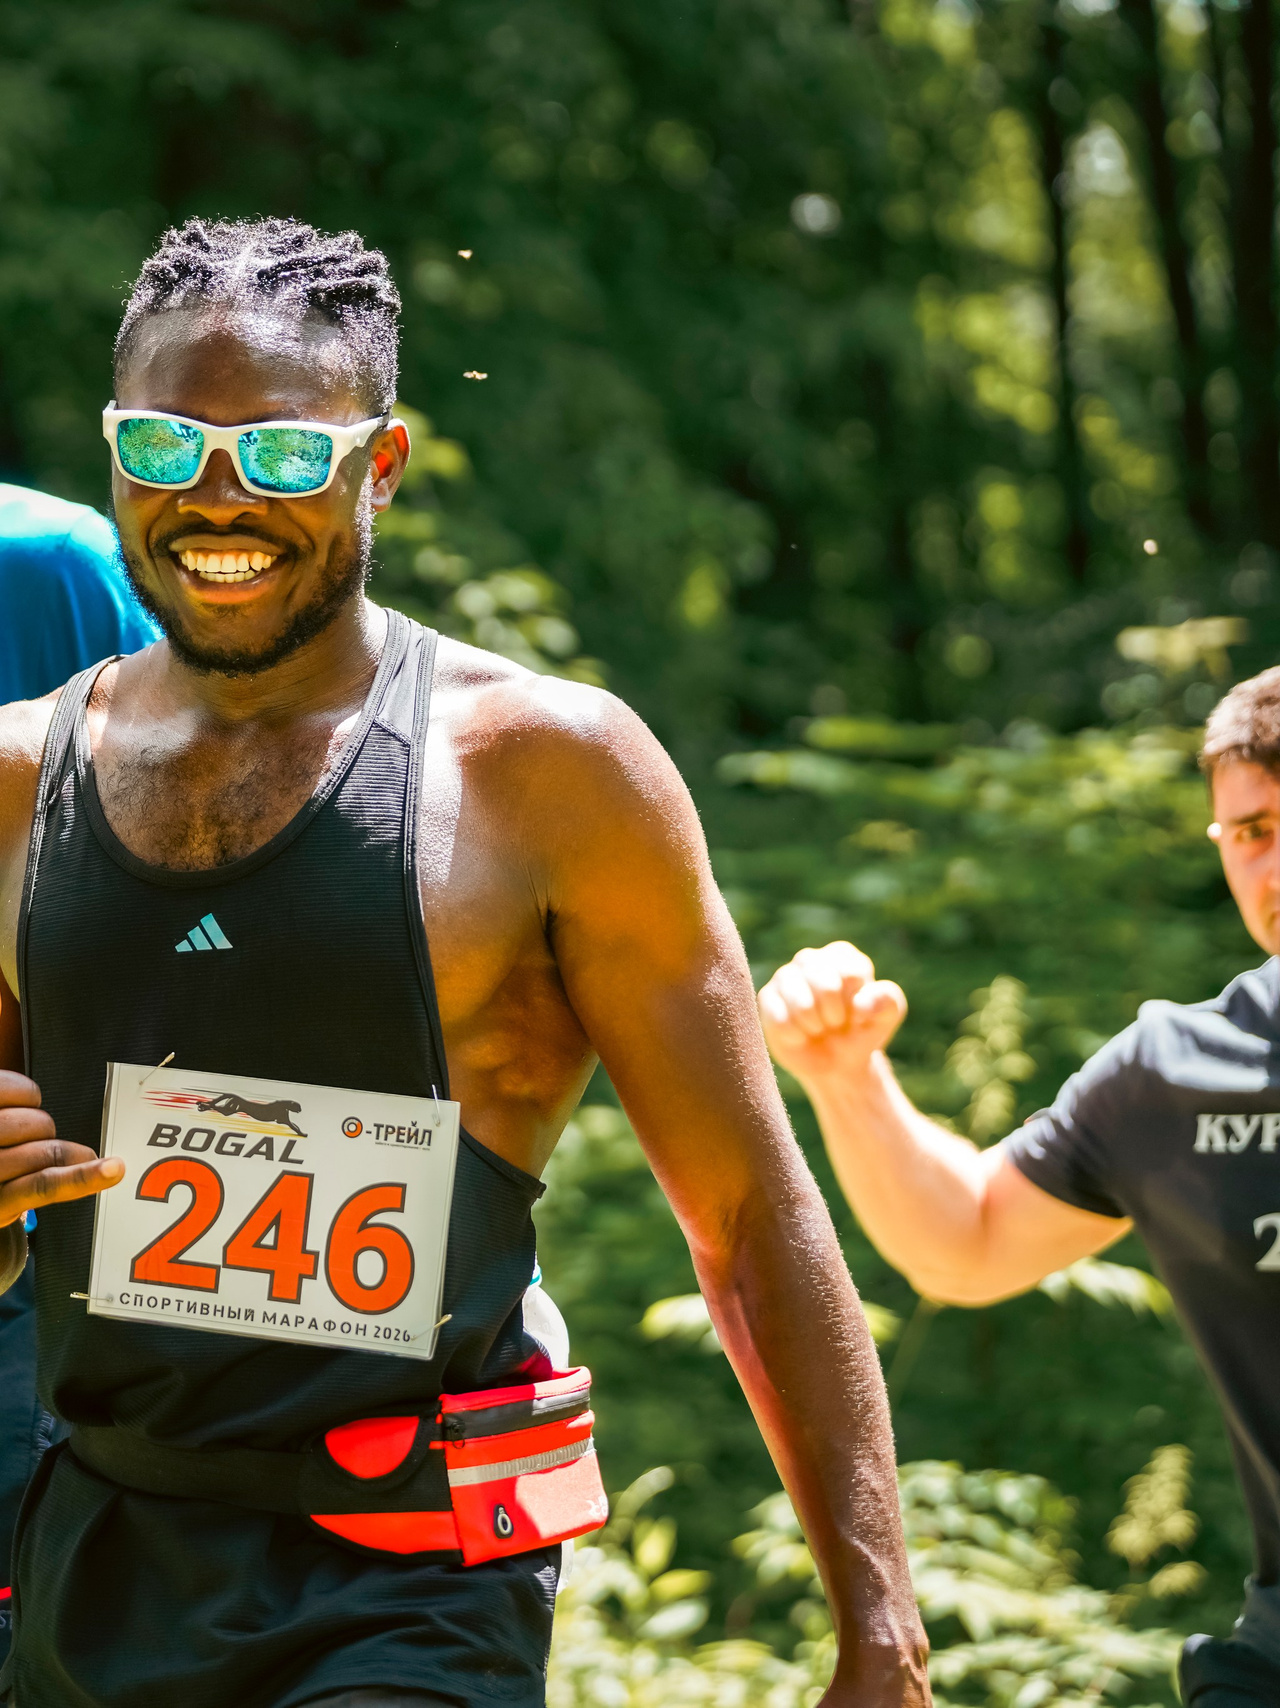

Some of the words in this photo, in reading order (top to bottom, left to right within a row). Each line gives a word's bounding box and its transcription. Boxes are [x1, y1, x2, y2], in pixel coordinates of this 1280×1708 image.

[147, 1123, 305, 1165] BOGAL
[129, 1155, 416, 1316] 246
[119, 1292, 255, 1322] СПОРТИВНЫЙ
[262, 1311, 367, 1338] МАРАФОН
[374, 1325, 411, 1343] 2026
